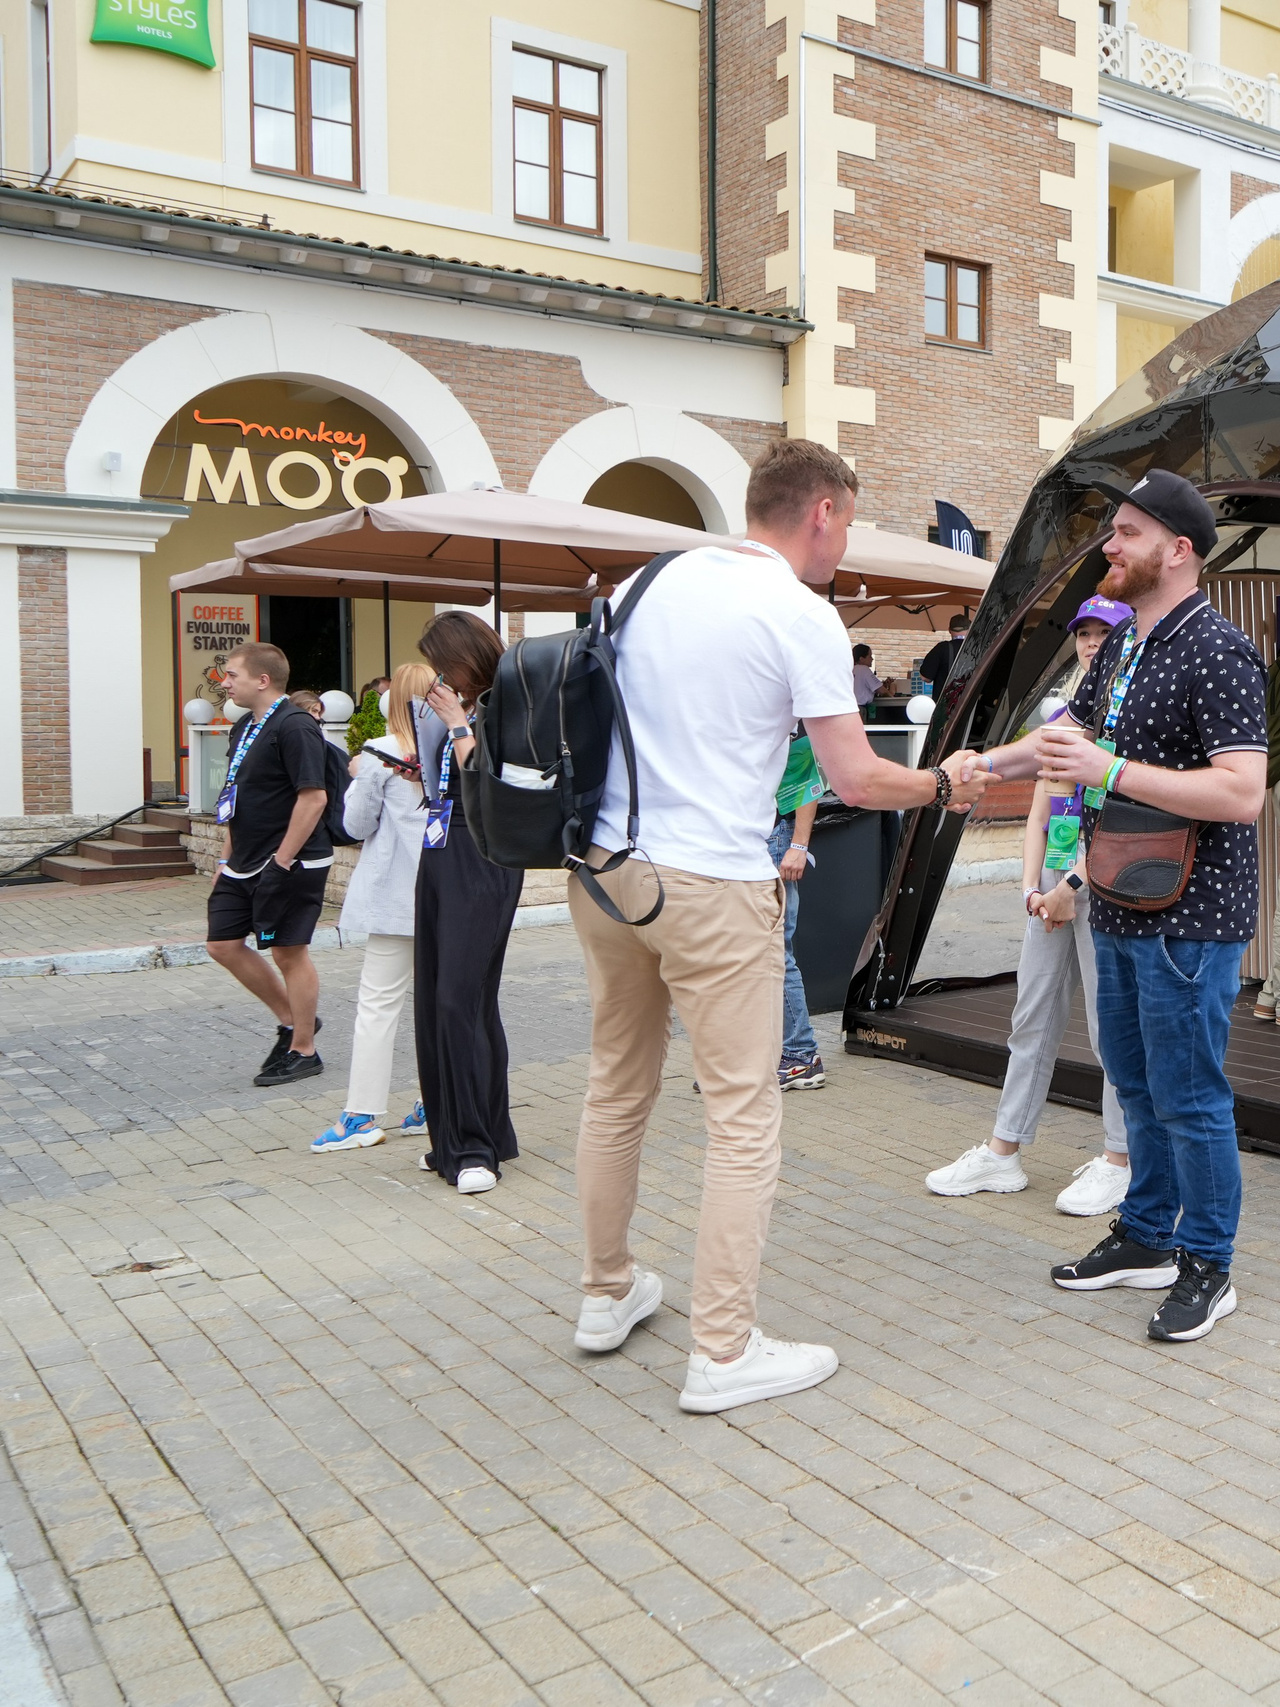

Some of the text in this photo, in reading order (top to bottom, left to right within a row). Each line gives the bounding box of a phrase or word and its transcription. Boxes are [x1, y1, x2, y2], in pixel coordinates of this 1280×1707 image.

[136, 24, 173, 39] HOTELS
[193, 409, 367, 461] monkey
[183, 443, 409, 510] MOO
[1097, 600, 1115, 610] сбп
[193, 605, 245, 621] COFFEE
[186, 621, 250, 635] EVOLUTION
